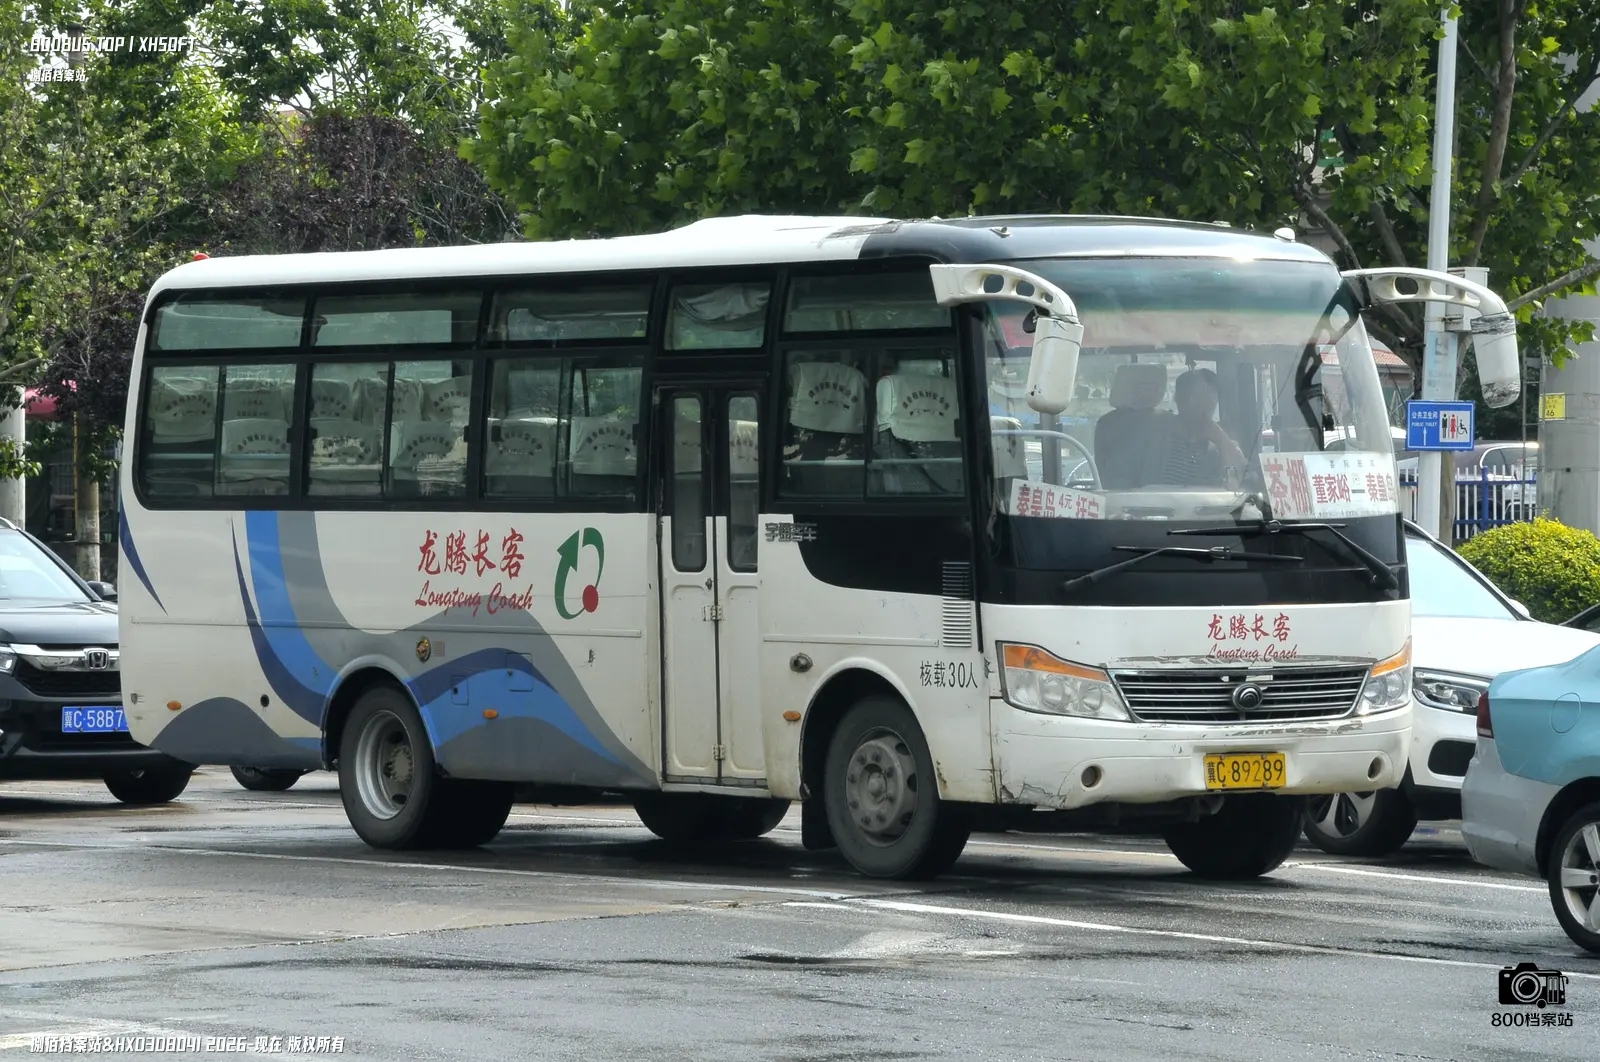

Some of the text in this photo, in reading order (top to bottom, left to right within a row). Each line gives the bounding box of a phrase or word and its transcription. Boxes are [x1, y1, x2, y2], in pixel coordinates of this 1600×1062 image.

[1411, 411, 1438, 420] 公共卫生间
[417, 526, 525, 581] 龙腾长客
[414, 579, 534, 618] Longteng Coach
[1207, 612, 1291, 642] 龙腾长客
[1205, 643, 1298, 667] Longteng Coach
[919, 660, 979, 689] 核载30人
[64, 710, 128, 729] 冀C·58B7
